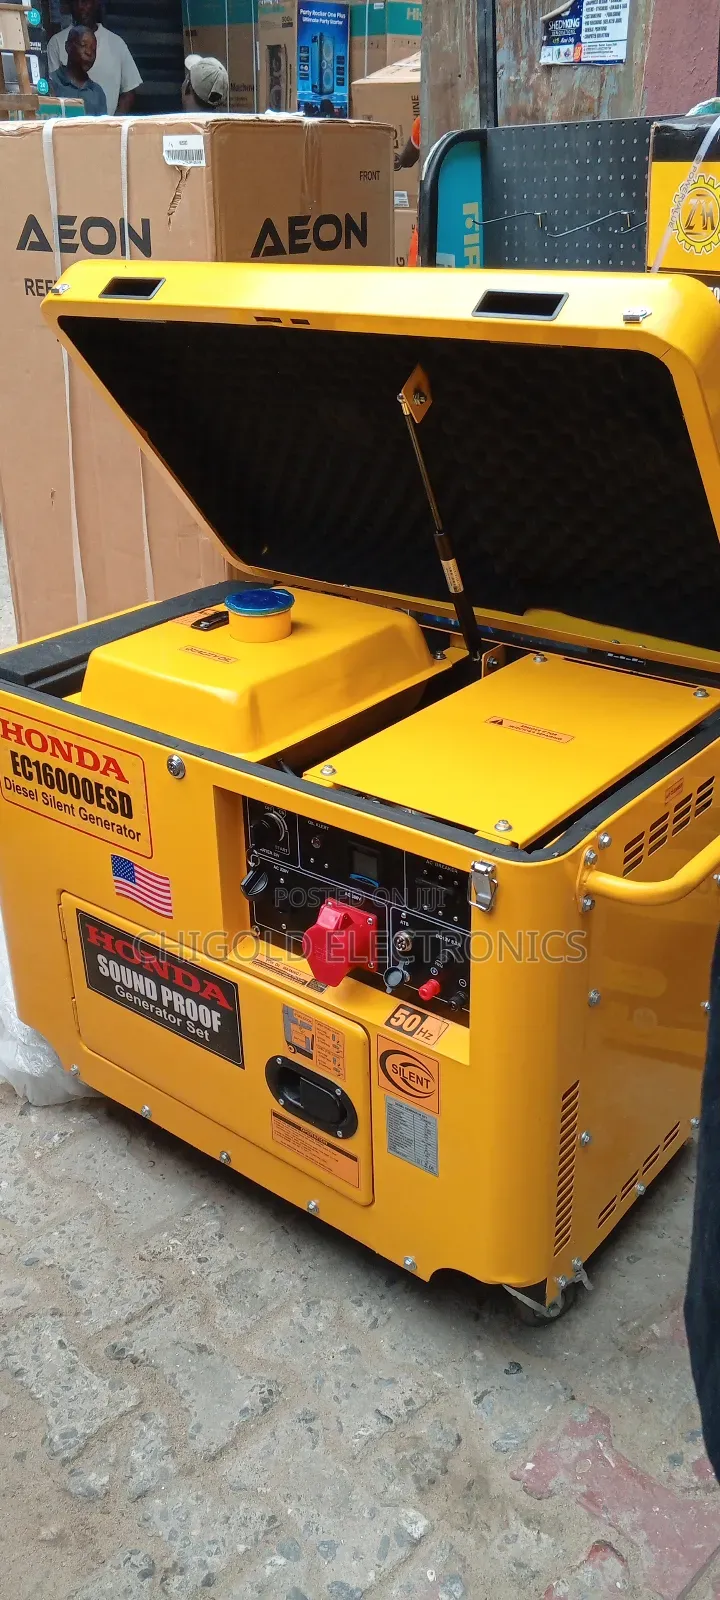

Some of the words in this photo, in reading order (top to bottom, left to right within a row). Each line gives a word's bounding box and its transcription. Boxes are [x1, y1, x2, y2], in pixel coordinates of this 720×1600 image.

[300, 8, 312, 16] Party
[320, 17, 330, 25] Party
[359, 169, 380, 182] FRONT
[16, 213, 152, 259] AEON
[250, 211, 368, 258] AEON
[24, 278, 58, 297] REF
[0, 716, 129, 785] HONDA
[10, 749, 134, 821] EC16000ESD
[4, 777, 40, 801] Diesel
[41, 790, 76, 818] Silent
[78, 805, 142, 844] Generator
[434, 862, 459, 874] BREAKER
[85, 923, 233, 1011] HONDA
[97, 953, 158, 1002] SOUND
[161, 984, 222, 1033] PROOF
[114, 984, 182, 1028] Generator
[186, 1020, 210, 1042] Set
[389, 1008, 421, 1032] 50
[417, 1026, 434, 1041] Hz
[391, 1064, 431, 1090] SILENT
